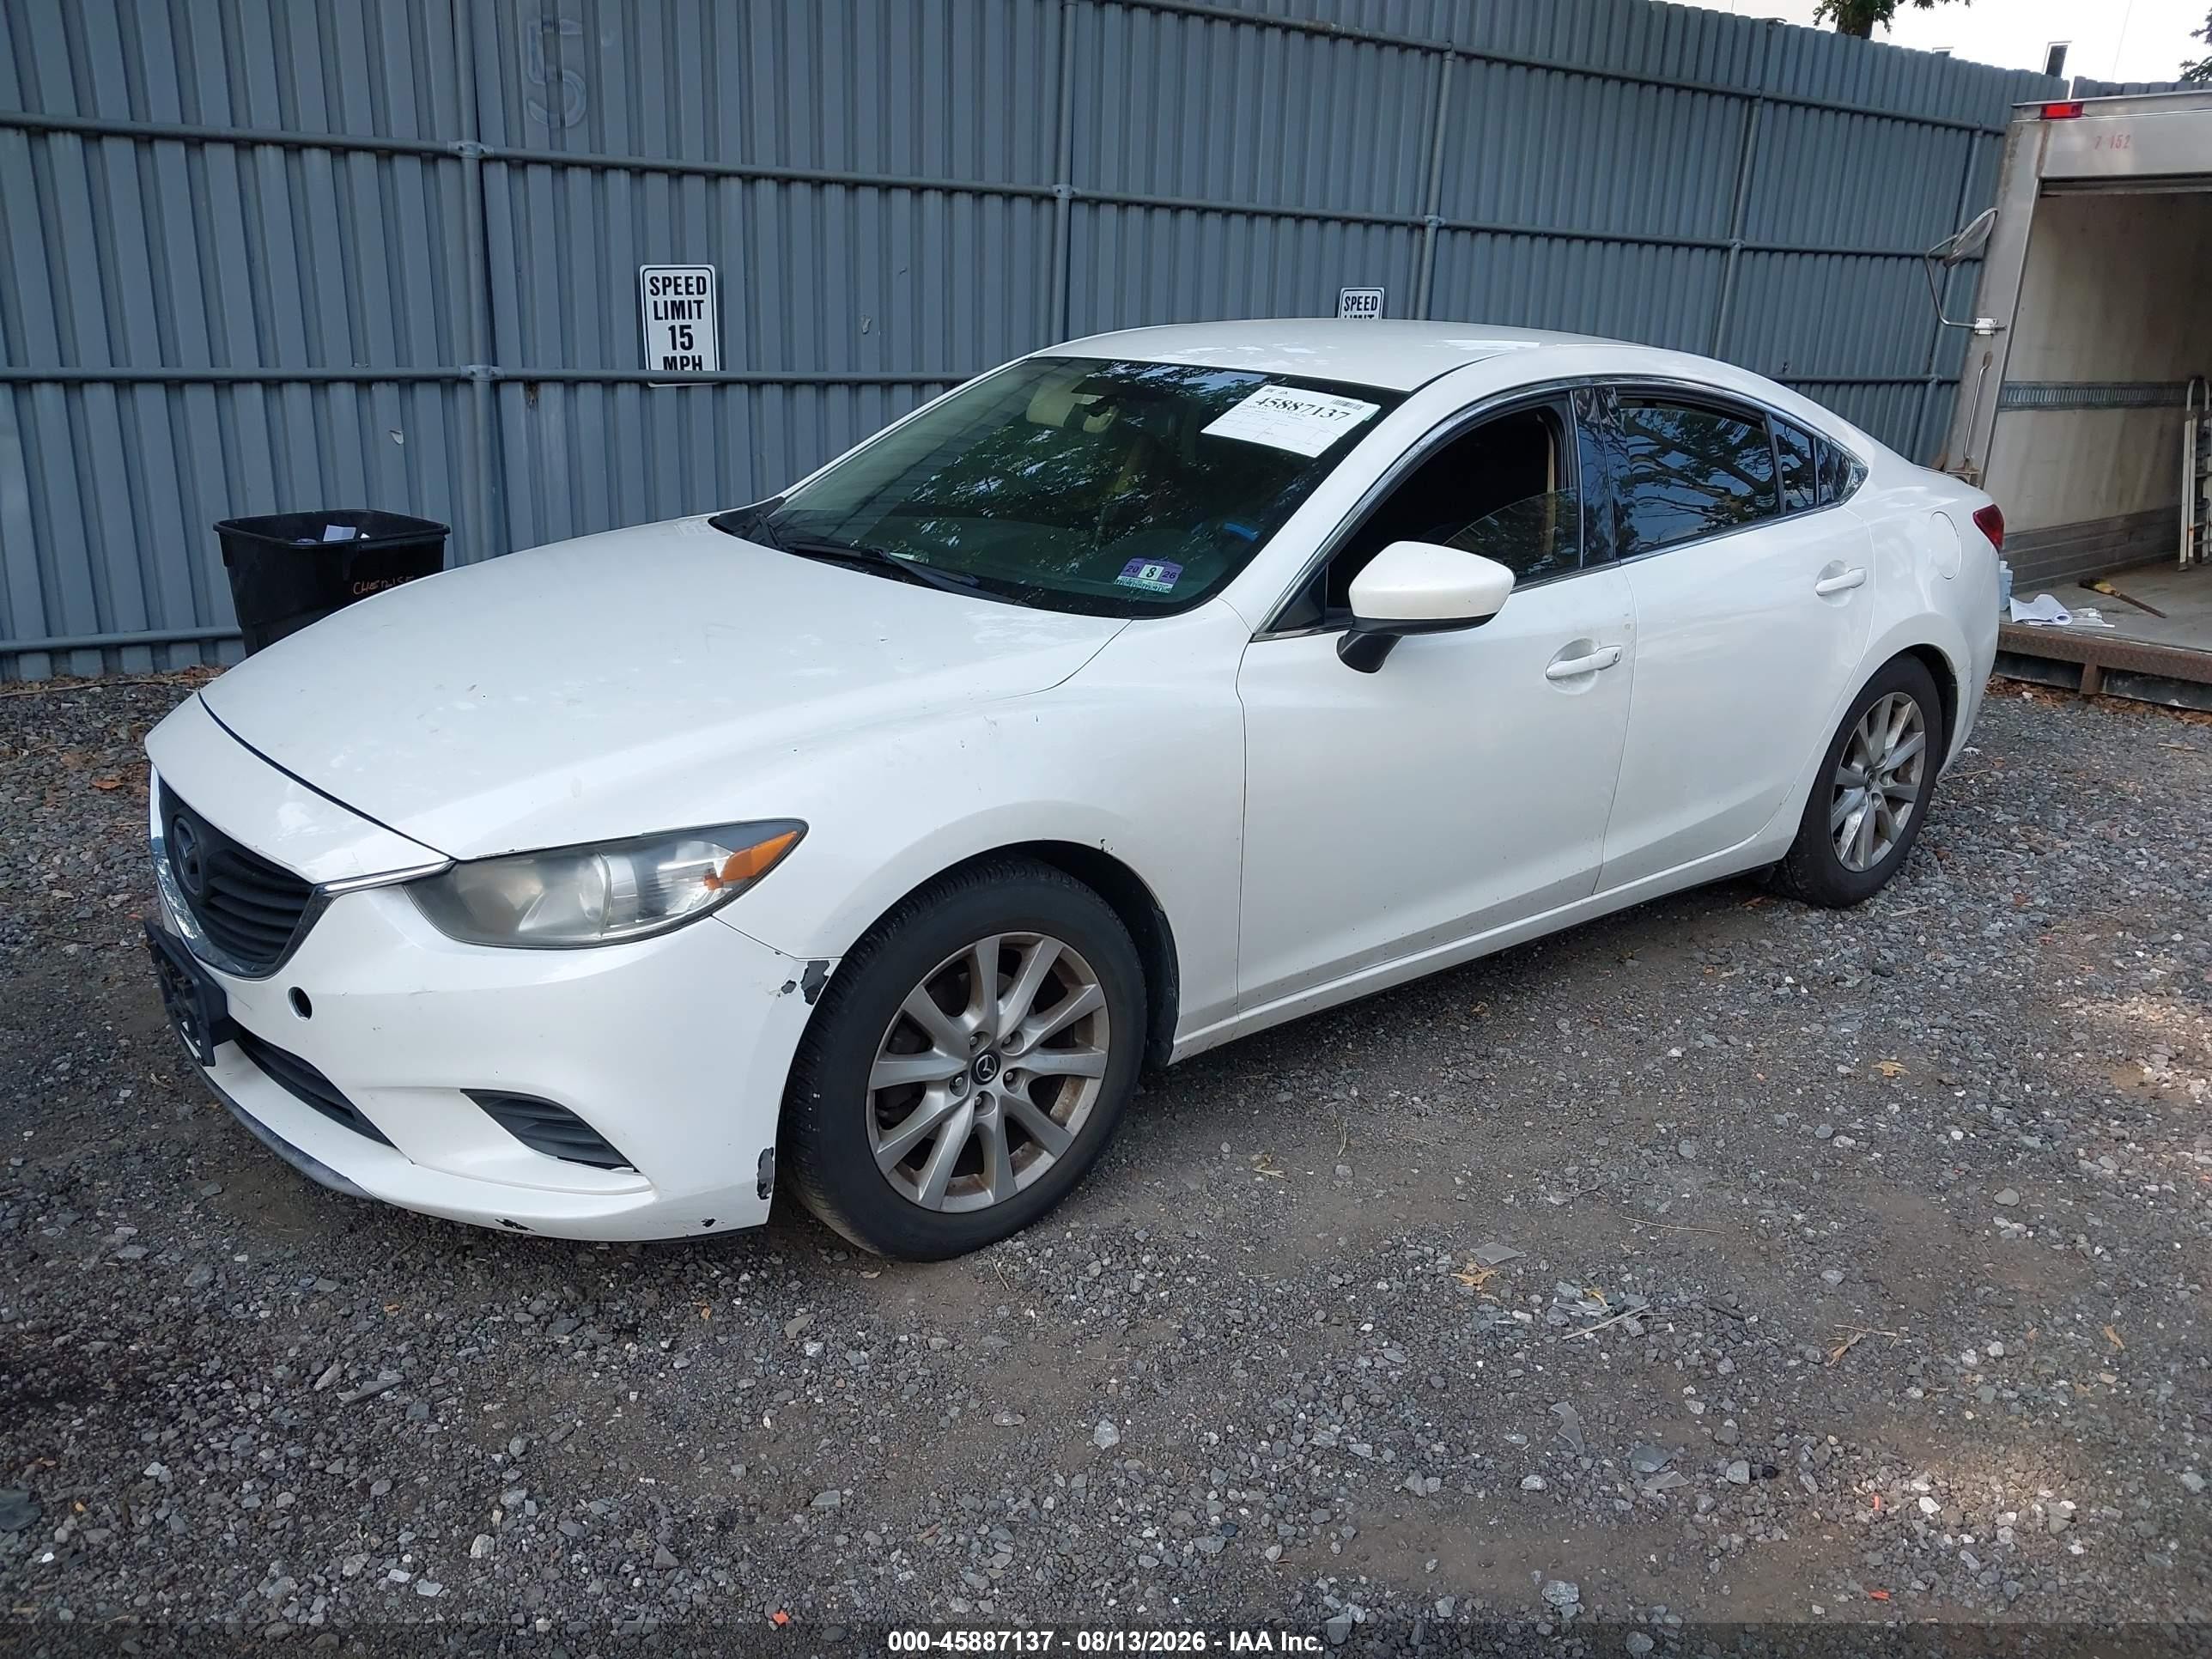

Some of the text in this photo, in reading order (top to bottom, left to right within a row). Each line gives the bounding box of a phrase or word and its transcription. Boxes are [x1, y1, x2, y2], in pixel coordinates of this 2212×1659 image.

[526, 18, 587, 128] 5
[2110, 134, 2130, 149] 152
[649, 276, 707, 296] SPEED
[653, 300, 704, 320] LIMIT
[1344, 295, 1378, 311] SPEED
[668, 325, 694, 350] 15
[662, 355, 702, 371] MPH
[1255, 397, 1351, 421] 45887137
[1126, 565, 1177, 579] 20 8 26
